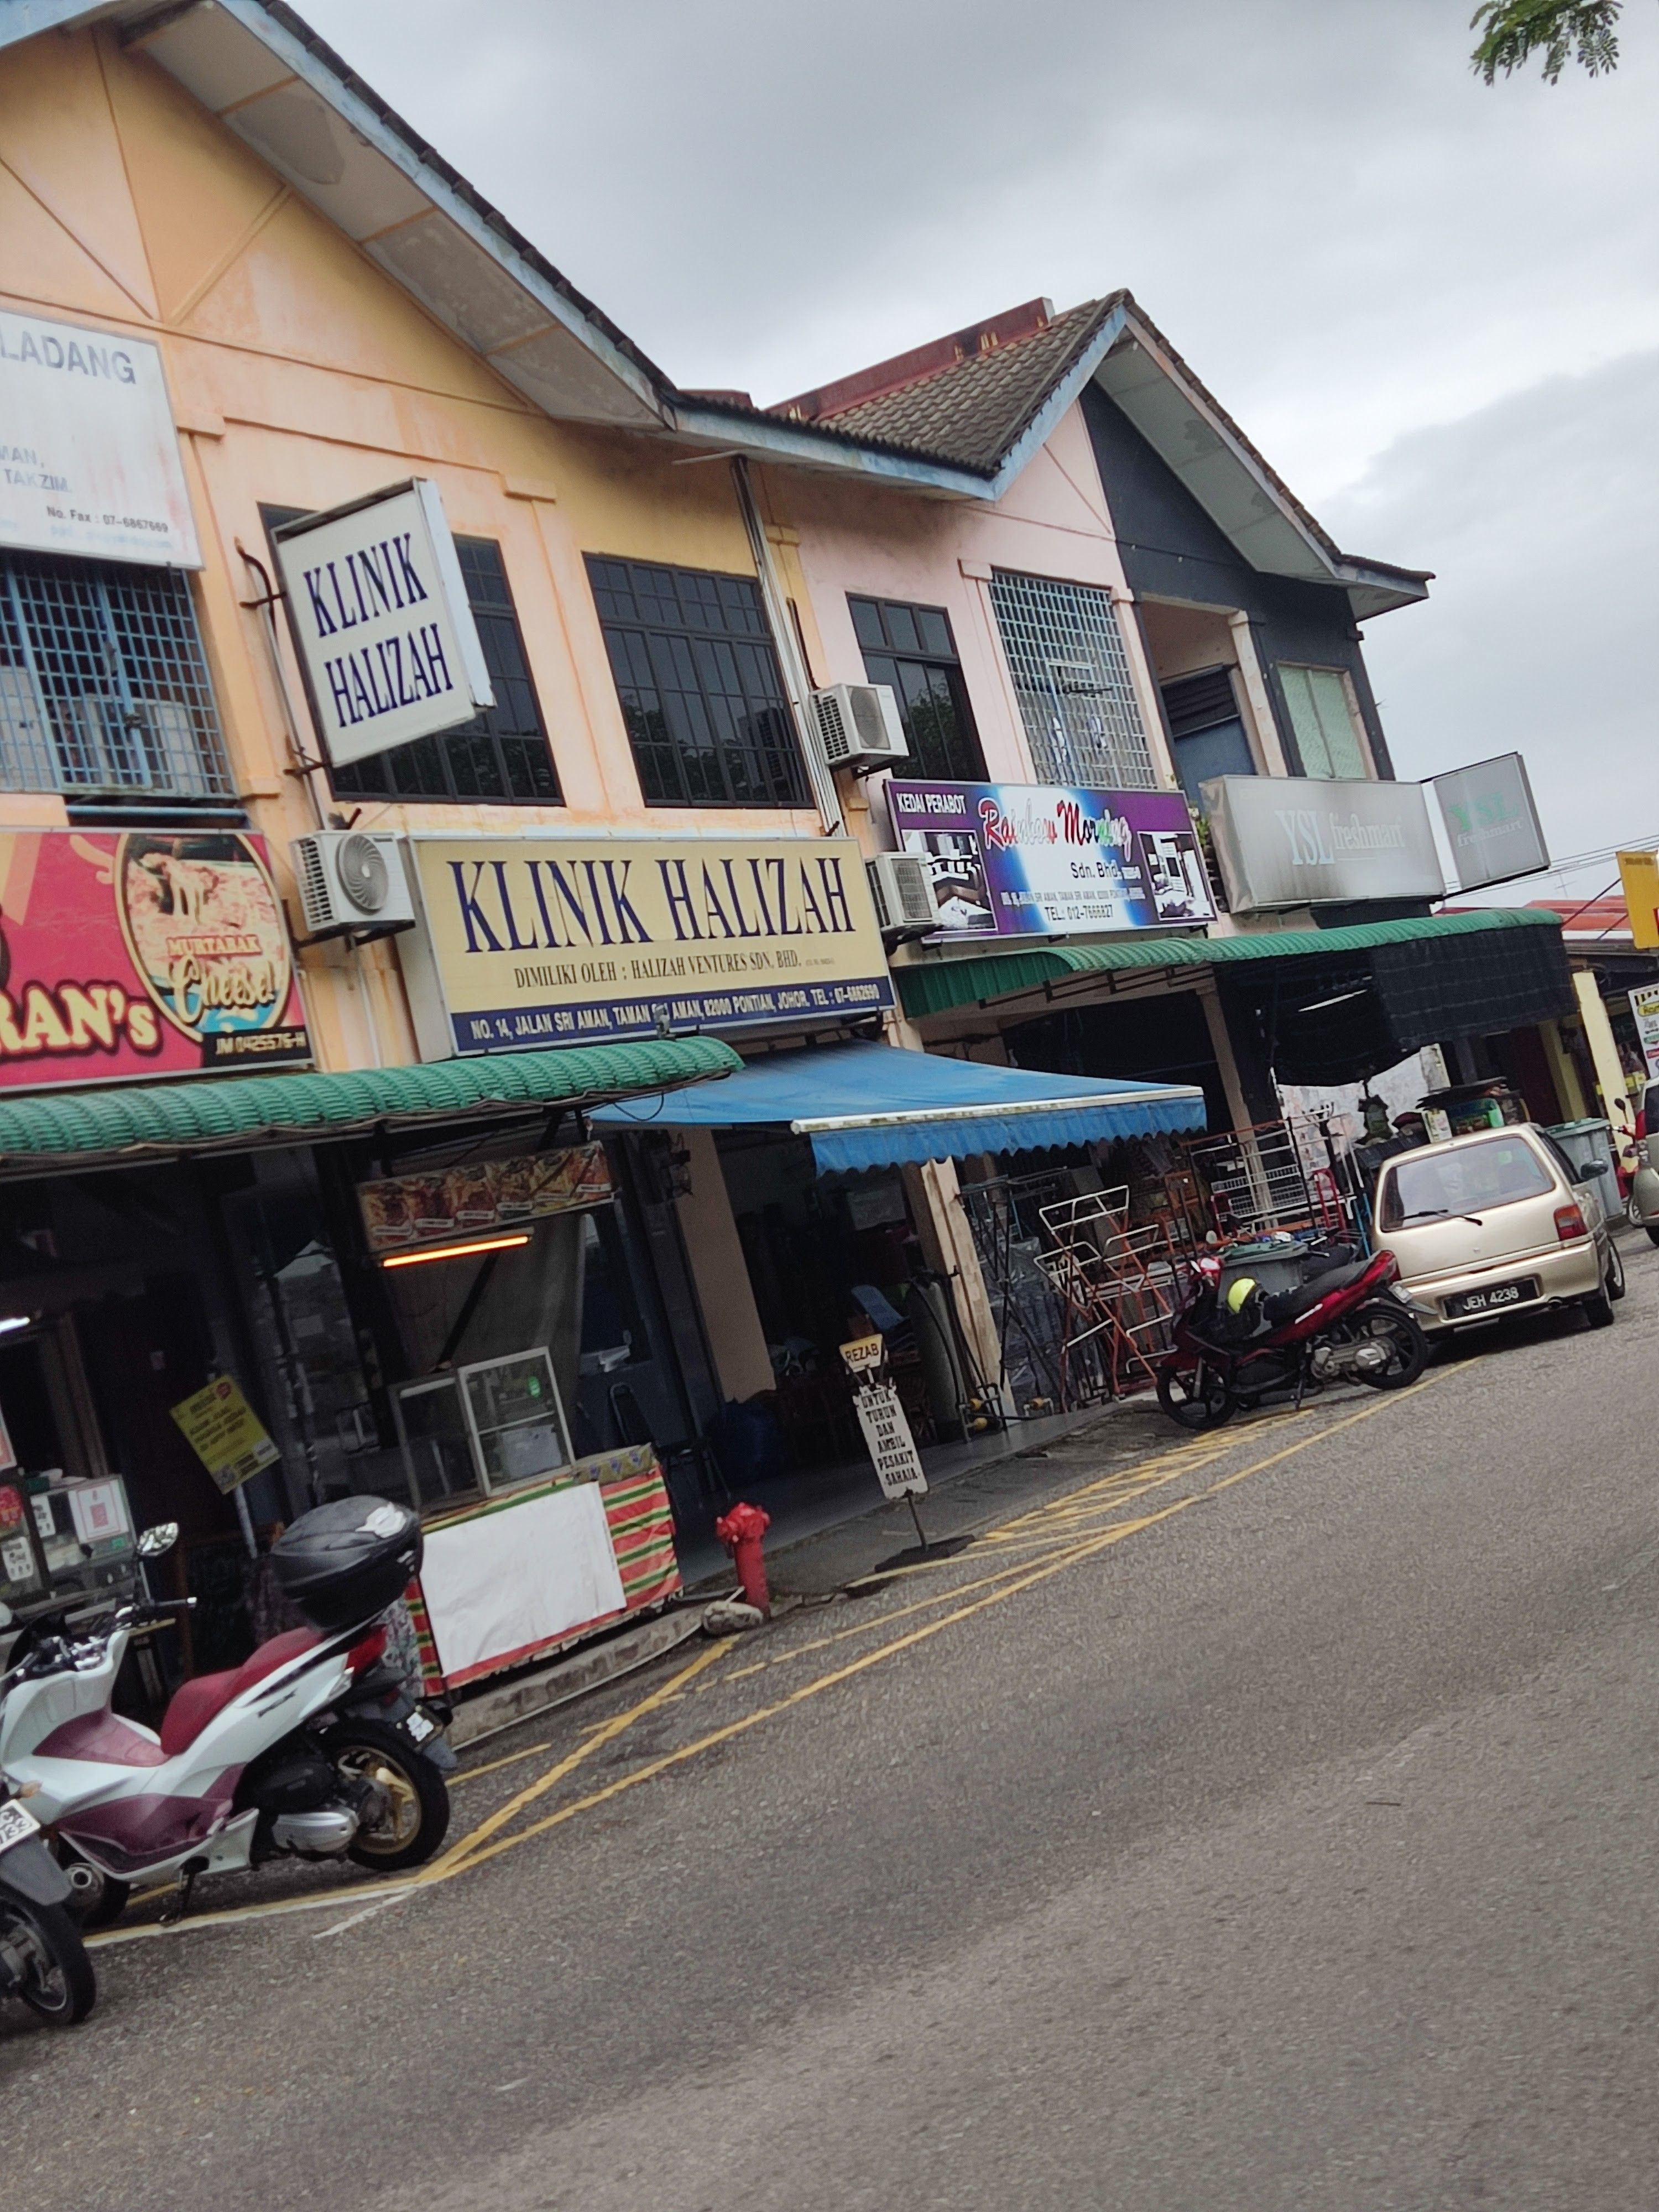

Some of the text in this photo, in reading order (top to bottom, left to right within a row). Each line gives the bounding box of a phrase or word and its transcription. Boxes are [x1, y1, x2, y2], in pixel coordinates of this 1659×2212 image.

[70, 509, 91, 523] Fax
[304, 532, 428, 638] KLINIK
[324, 623, 453, 728] HALIZAH
[896, 792, 967, 815] KEDAI PERABOT
[1447, 791, 1519, 832] YSL
[1274, 810, 1335, 865] YSL
[1070, 862, 1095, 879] Sdn.
[1096, 859, 1121, 879] Bhd.
[446, 857, 855, 953] KLINIK HALIZAH
[167, 935, 262, 957] MURTABAK
[514, 964, 577, 988] DIMILIKI
[581, 961, 617, 983] OLEH
[630, 957, 686, 979] HALIZAH
[688, 953, 748, 974] VENTURES
[749, 951, 775, 970] SDN.
[776, 950, 802, 968] BHD.
[470, 1019, 494, 1040] NO.
[515, 1013, 554, 1036] JALAN
[554, 1011, 575, 1032] SRI
[577, 1008, 613, 1030] AMAN,
[612, 1004, 651, 1025] TAMAN
[671, 1000, 705, 1020] AMAN,
[733, 994, 777, 1014] PONTIAN,
[1462, 1286, 1520, 1311] JEH 4238
[844, 1343, 880, 1363] REZAB
[865, 1404, 897, 1423] TURUN
[875, 1421, 895, 1437] DAN
[877, 1435, 906, 1453] AMBIL
[877, 1449, 914, 1472] PESAKIT
